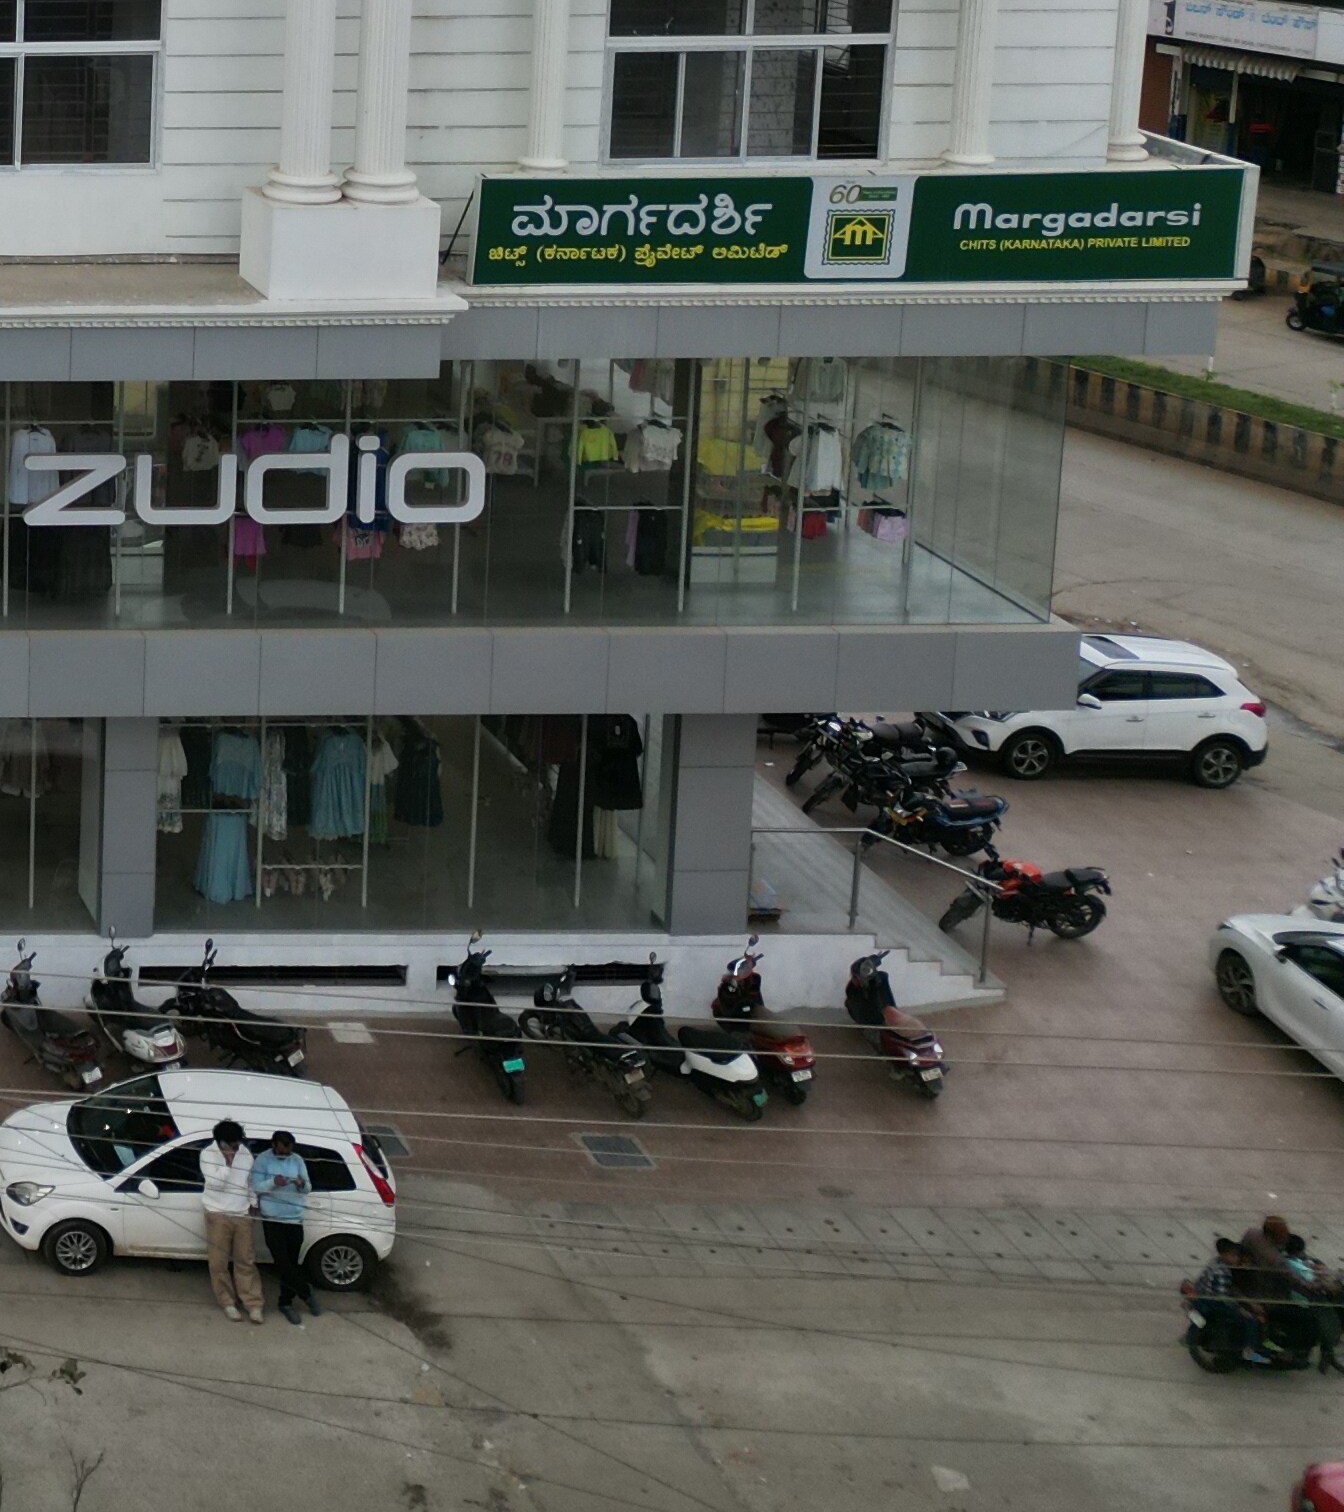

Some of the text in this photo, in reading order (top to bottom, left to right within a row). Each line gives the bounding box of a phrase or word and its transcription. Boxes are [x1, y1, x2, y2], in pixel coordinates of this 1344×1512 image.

[828, 184, 862, 204] 60
[512, 193, 773, 236] ಮಾರ್ಗದರ್ಶಿ
[953, 202, 1202, 237] Margadarsi
[536, 243, 627, 263] (ಕರ್ನಾಟಕ)
[959, 236, 1191, 251] CHITS (KARNATAKA) PRIVATE LIMITED
[22, 433, 486, 526] zudio
